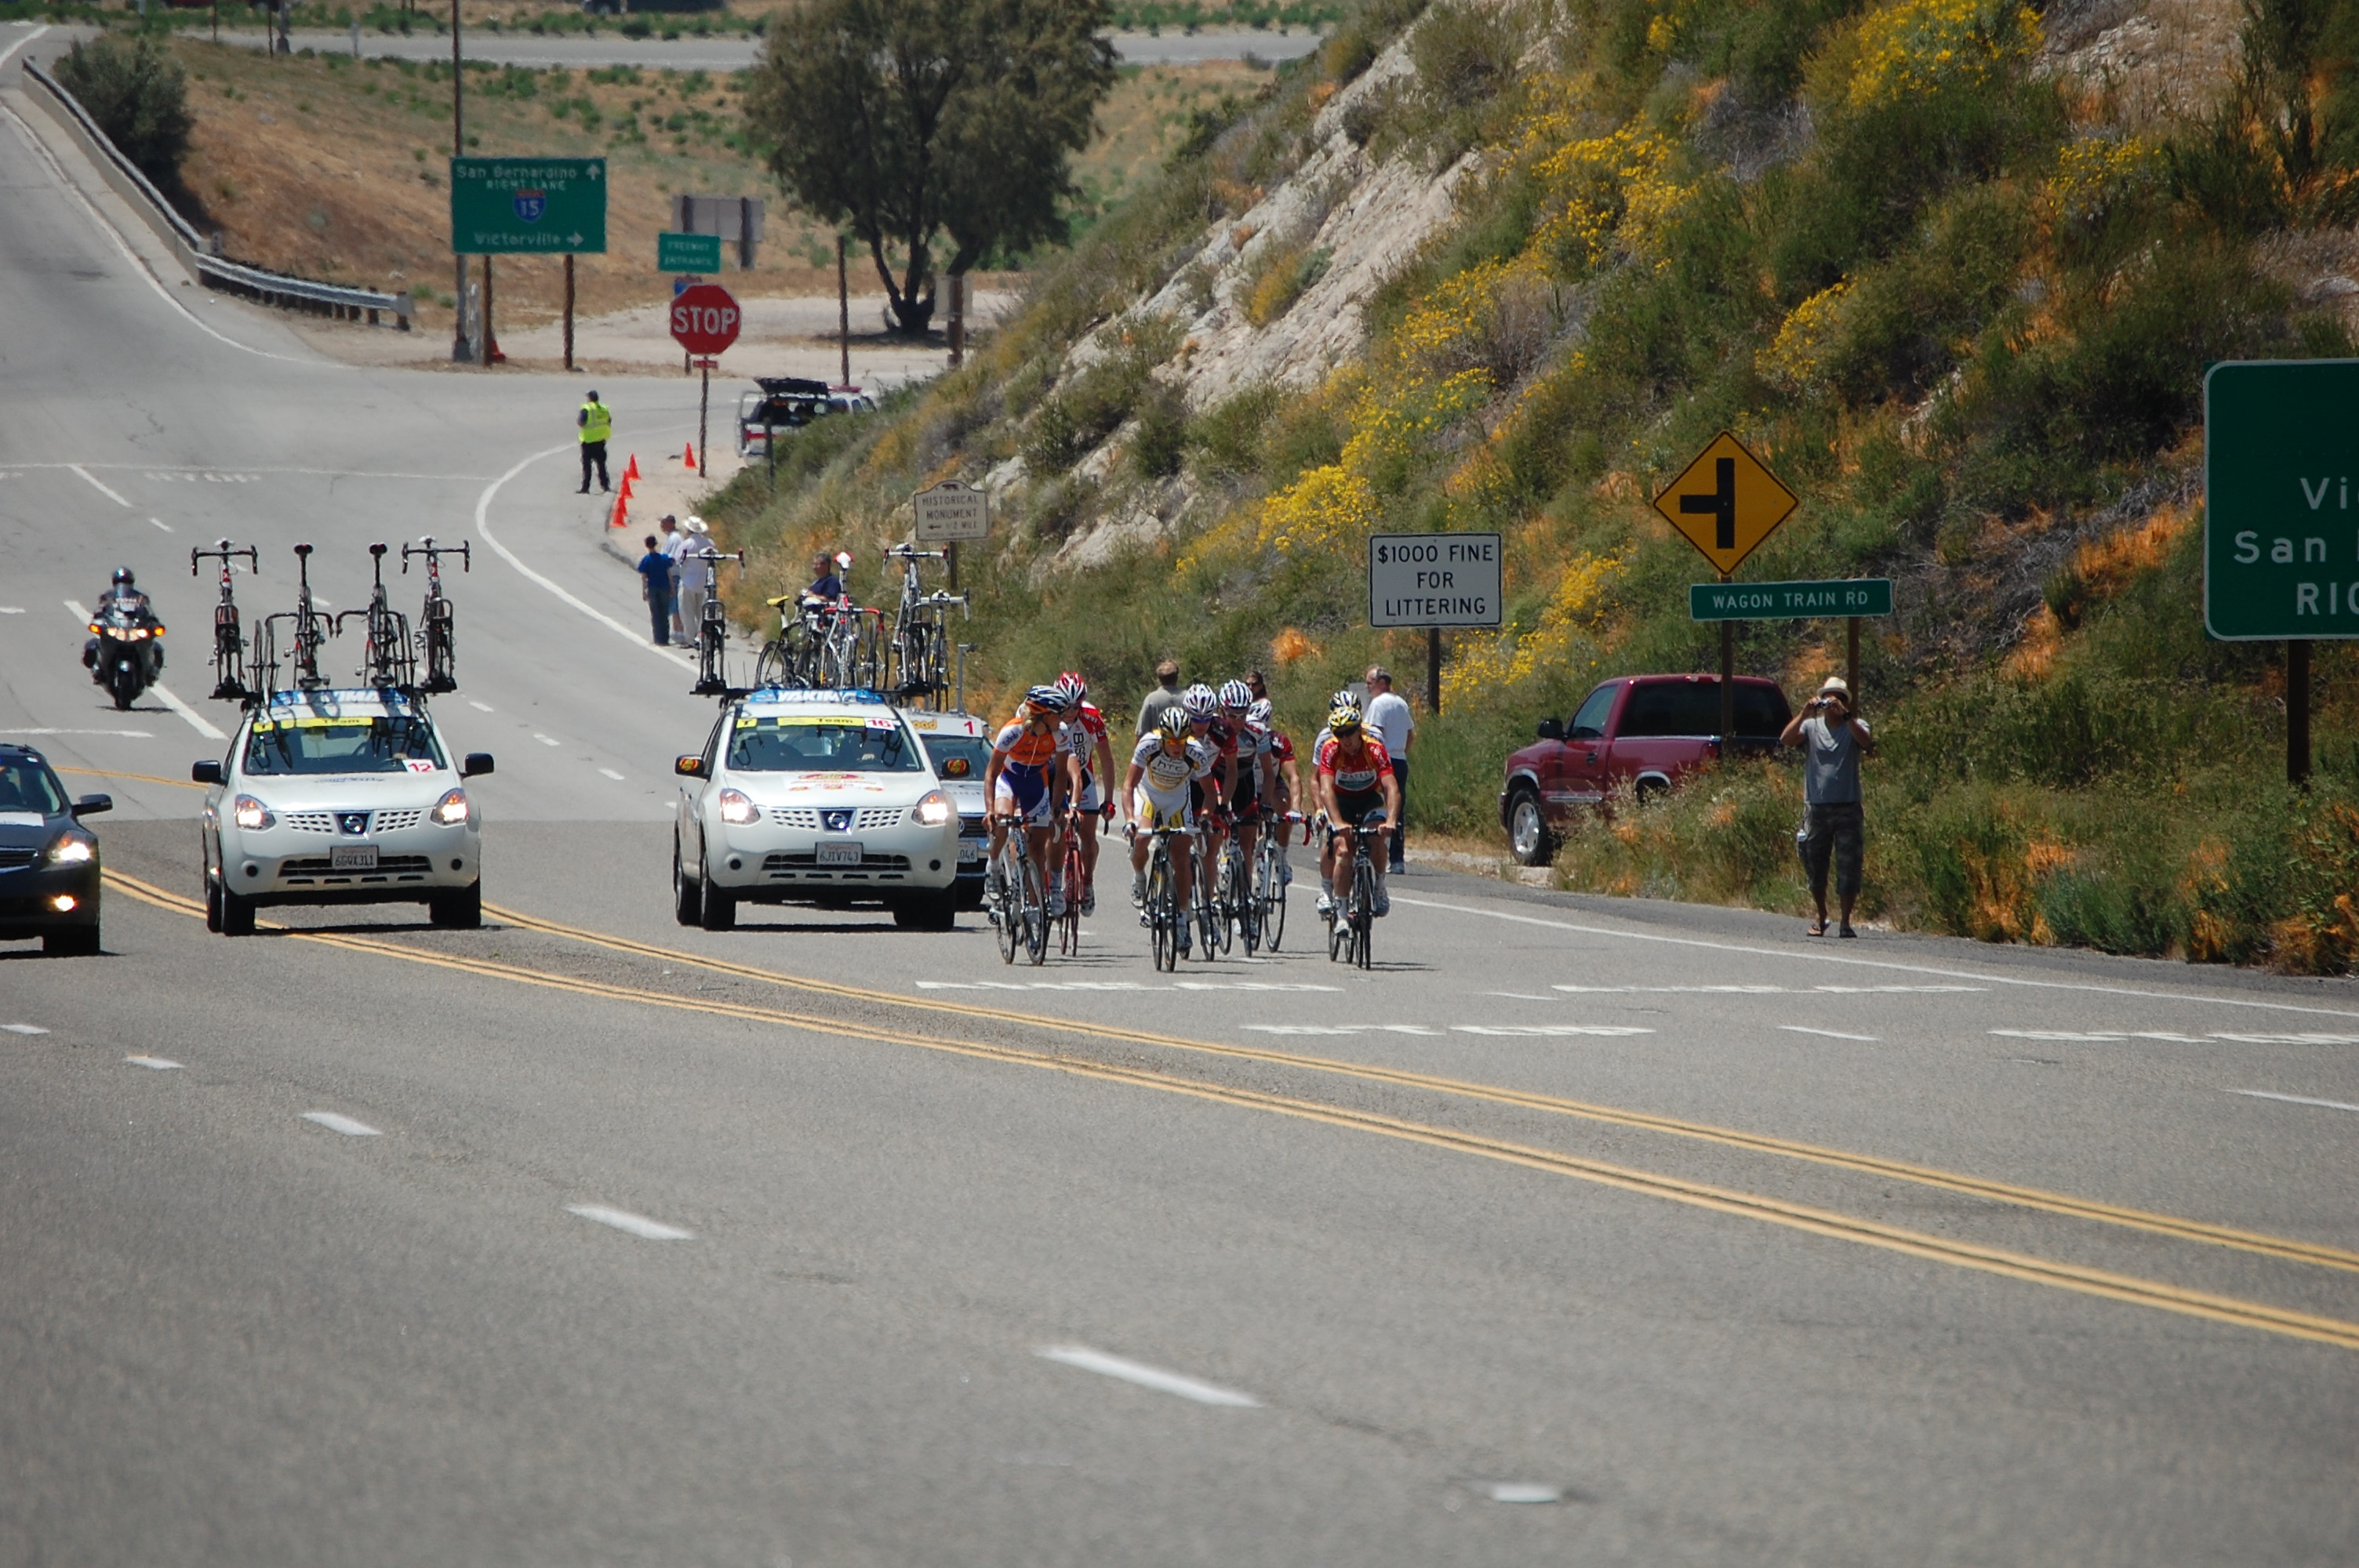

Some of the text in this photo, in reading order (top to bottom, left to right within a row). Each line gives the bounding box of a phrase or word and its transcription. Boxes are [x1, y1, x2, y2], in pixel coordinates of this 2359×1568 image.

[456, 163, 578, 179] San Bernardino
[519, 198, 540, 216] 15
[473, 230, 562, 246] Victorville
[673, 305, 737, 336] STOP
[922, 495, 978, 506] HISTORICAL
[2299, 476, 2359, 510] Vi
[926, 508, 976, 520] MONUMENT
[1377, 543, 1495, 565] $1000 FINE
[2234, 529, 2327, 564] San
[1416, 570, 1455, 590] FOR
[1385, 596, 1487, 618] LITTERING
[1712, 591, 1869, 609] WAGON TRAIN RD
[867, 718, 892, 728] 16
[911, 718, 938, 731] oad
[964, 720, 974, 735] 1
[408, 763, 431, 772] 12
